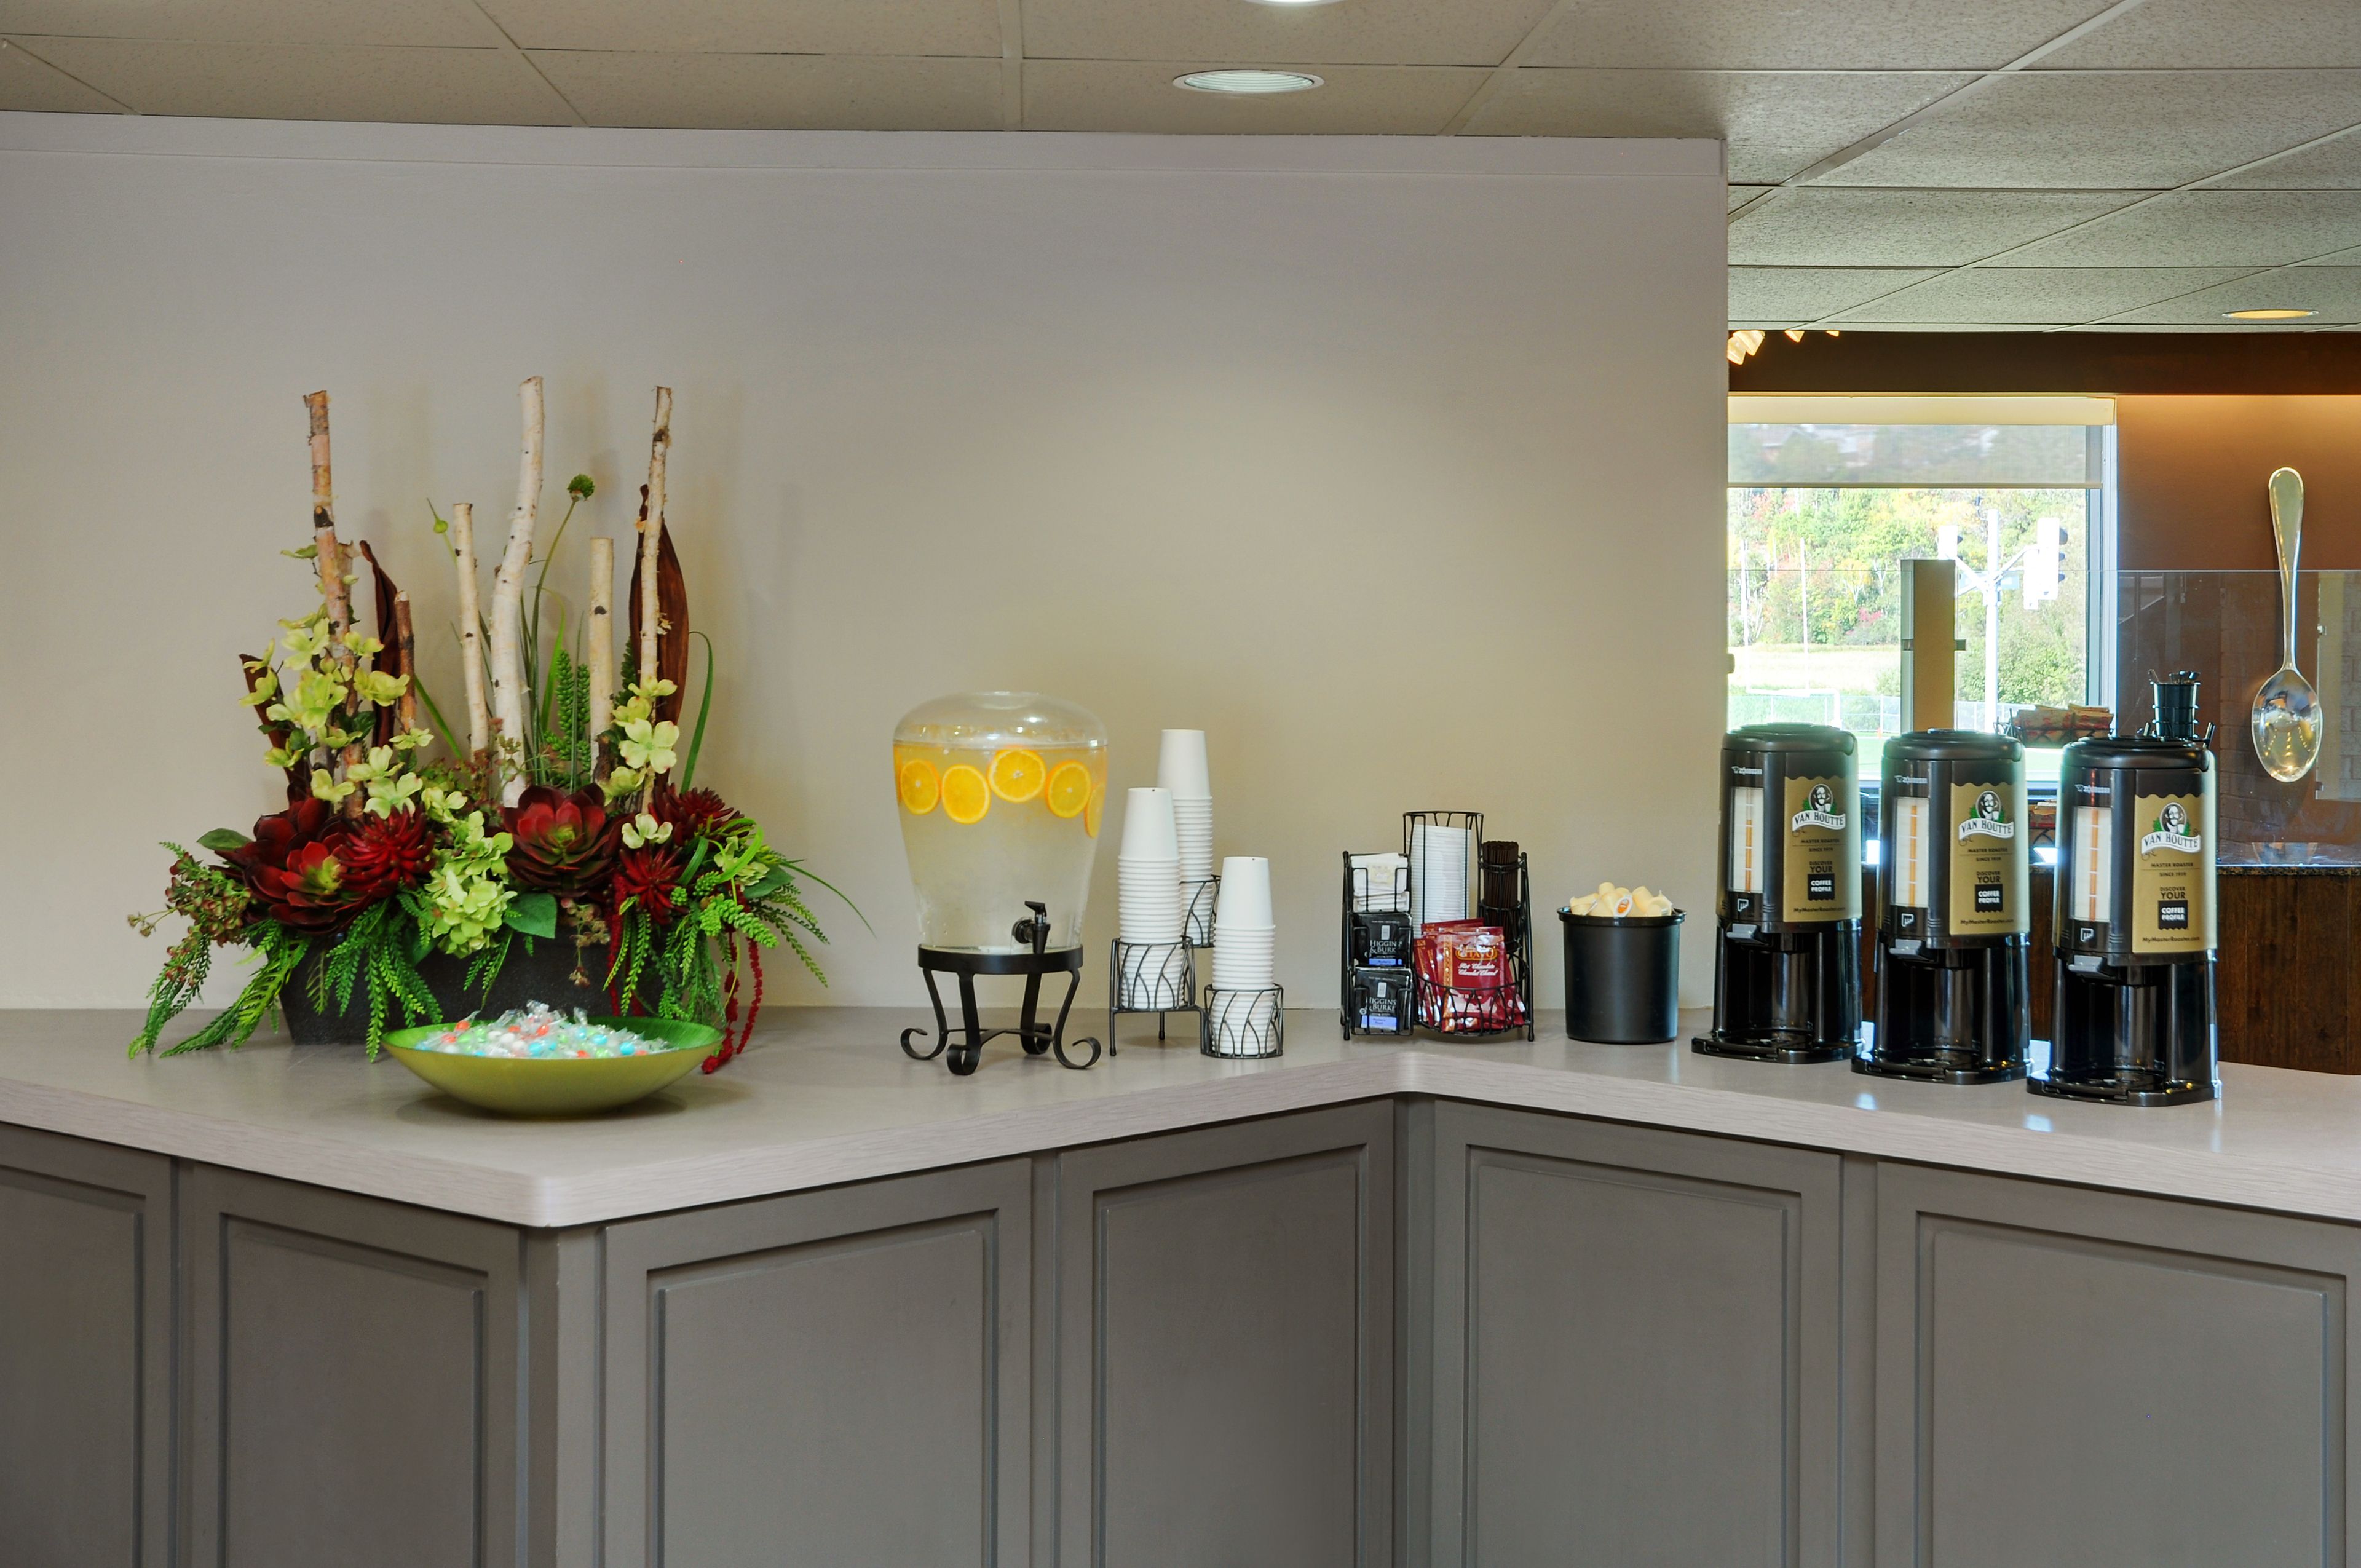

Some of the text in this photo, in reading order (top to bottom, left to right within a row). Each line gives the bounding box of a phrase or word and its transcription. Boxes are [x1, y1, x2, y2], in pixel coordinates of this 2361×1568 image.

[1795, 812, 1843, 825] VAN HOUTTE
[1961, 820, 2012, 834] VAN HOUTTE
[2145, 833, 2198, 848] VAN HOUTTE
